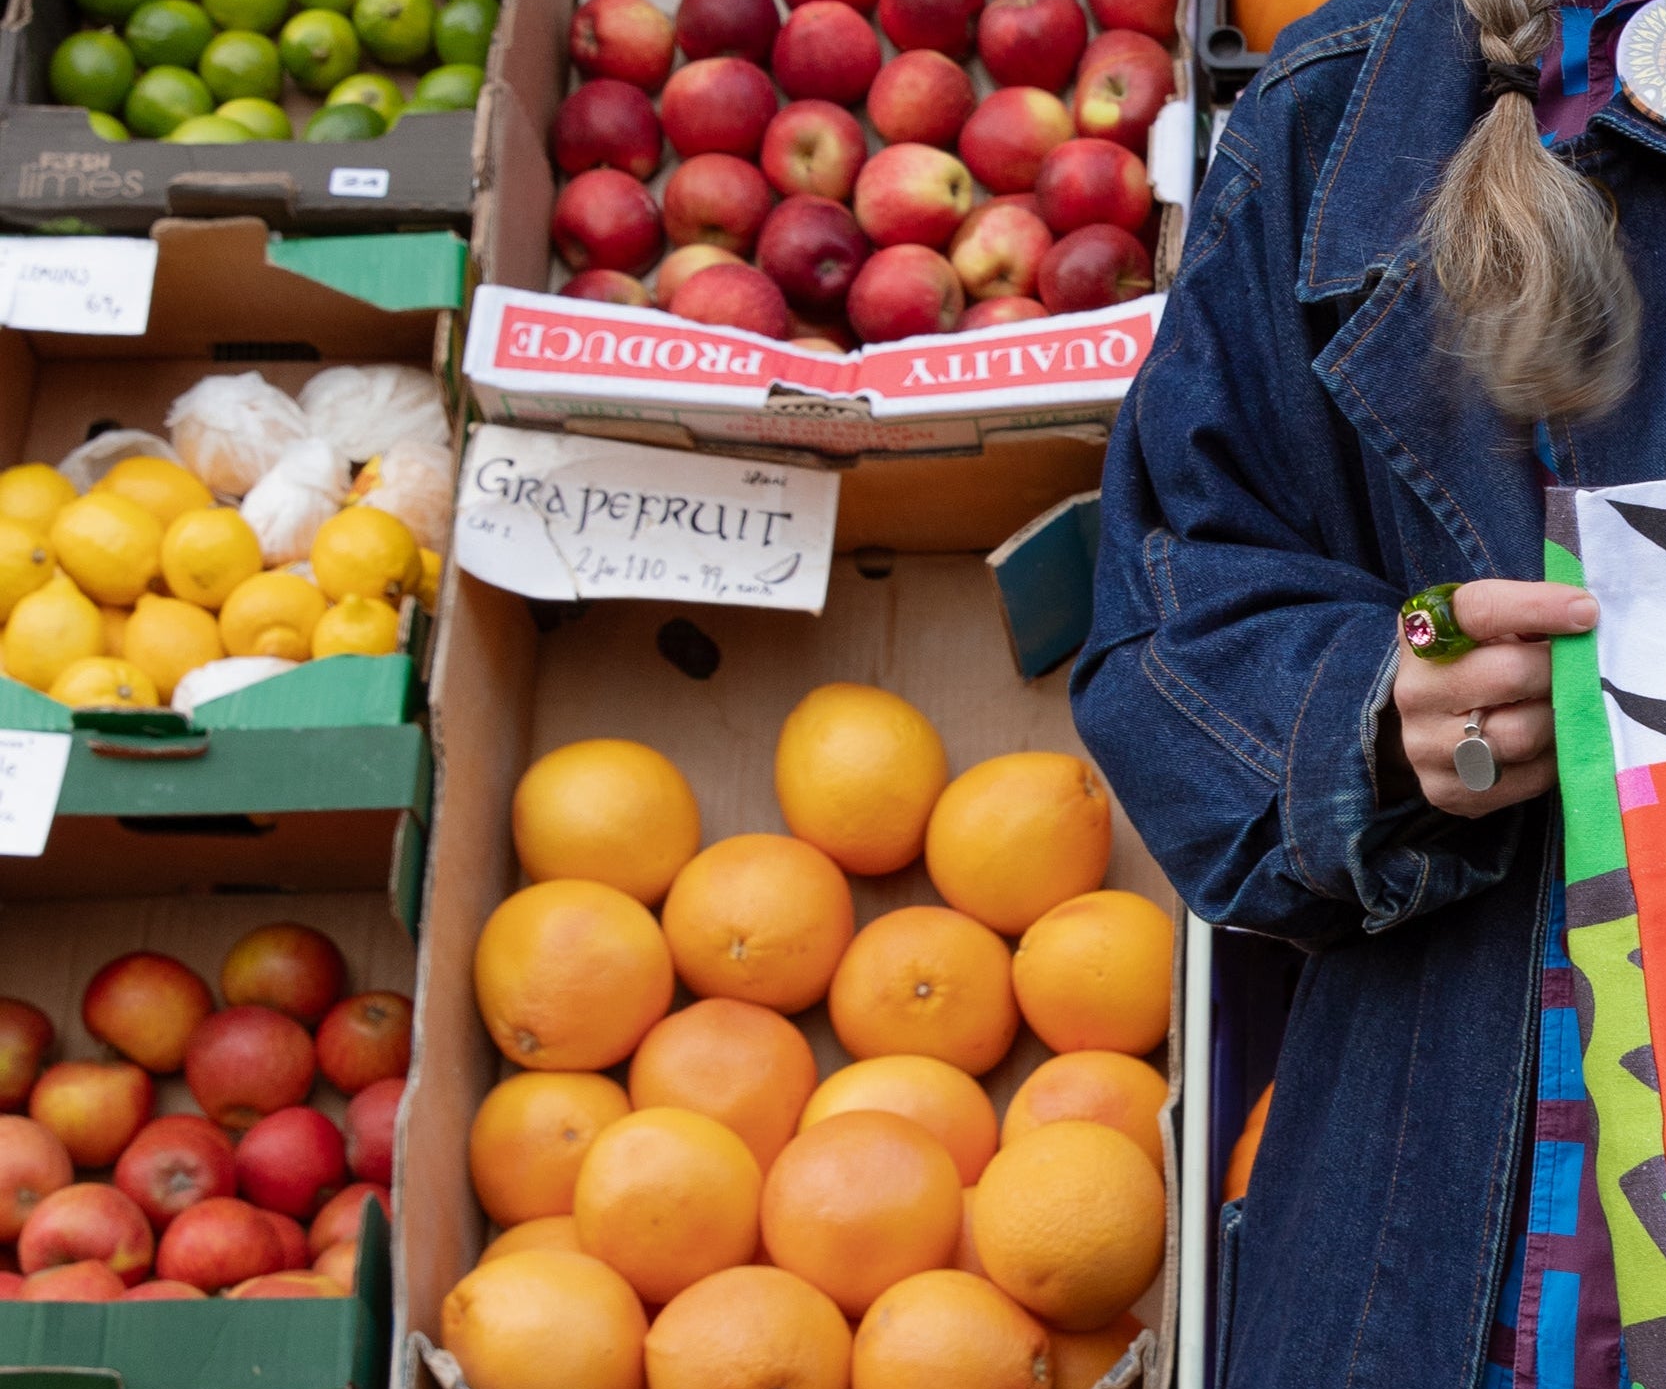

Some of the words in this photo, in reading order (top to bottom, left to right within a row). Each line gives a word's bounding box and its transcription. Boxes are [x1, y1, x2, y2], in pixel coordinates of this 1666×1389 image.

[17, 161, 145, 199] limes
[508, 320, 765, 377] PRODUCE
[903, 329, 1139, 388] QUALITY
[475, 457, 792, 548] GRAPEFRUIT
